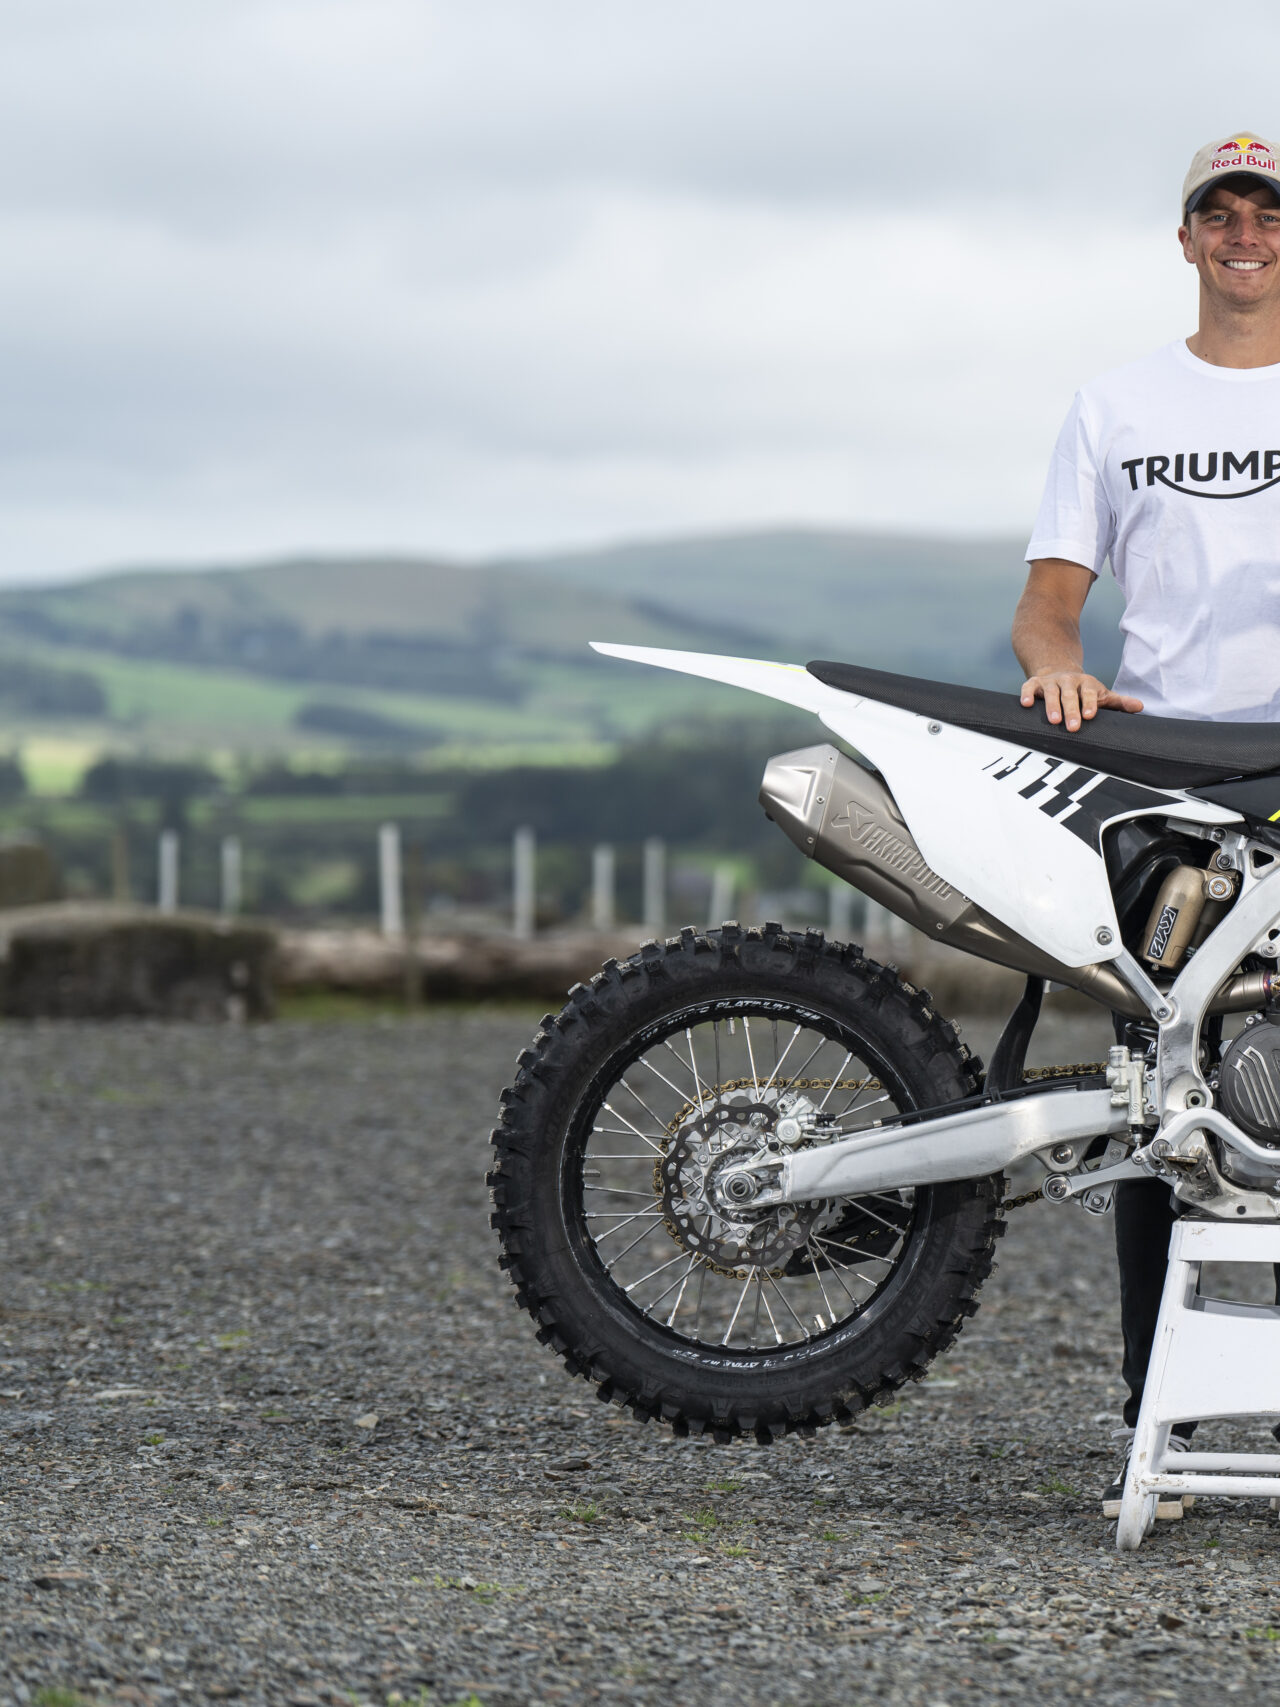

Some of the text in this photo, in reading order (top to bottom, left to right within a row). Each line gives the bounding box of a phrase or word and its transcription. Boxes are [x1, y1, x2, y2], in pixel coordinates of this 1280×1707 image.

[1211, 154, 1276, 171] Red Bull
[1150, 905, 1177, 958] KYB
